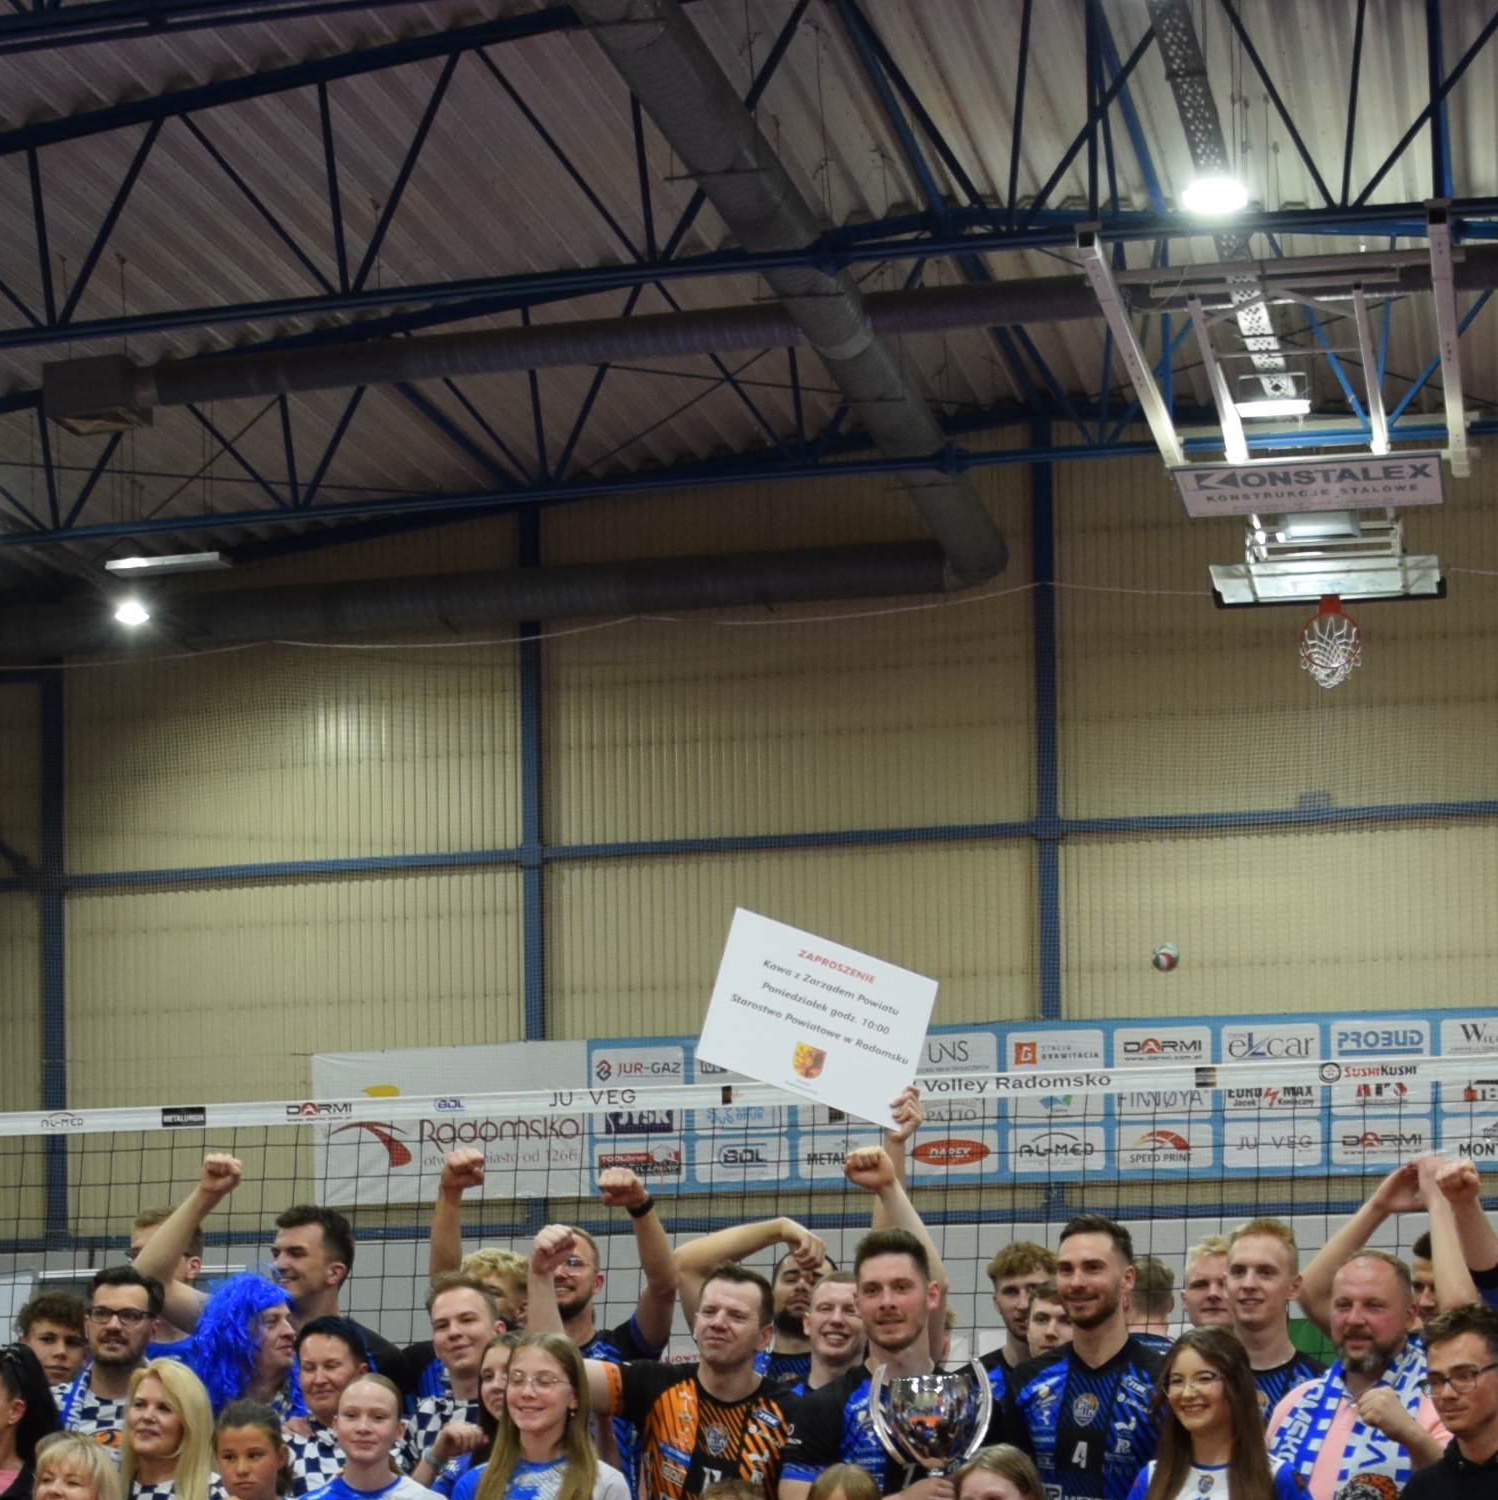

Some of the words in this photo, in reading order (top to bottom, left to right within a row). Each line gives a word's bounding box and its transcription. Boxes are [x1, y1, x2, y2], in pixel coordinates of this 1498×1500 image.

[1194, 463, 1433, 491] KONSTALEX
[1206, 488, 1329, 503] KONSTRUKCJE
[1340, 484, 1418, 496] STALOWE
[798, 949, 876, 984] ZAPROSZENIE
[762, 959, 792, 976] Kawa
[802, 974, 855, 999] Zarządem
[857, 993, 899, 1016] Powiatu
[761, 982, 829, 1013] Poniedziałek
[829, 1007, 858, 1024] godz.
[862, 1018, 890, 1035] 10:00
[730, 993, 782, 1018] Starostwo
[784, 1013, 841, 1040] Powiatowe
[855, 1039, 909, 1065] Radomsku
[1124, 1038, 1202, 1053] DARMI
[1337, 1030, 1424, 1048] PROBUD
[1042, 1051, 1099, 1061] GRAWITACJA
[617, 1062, 681, 1077] JUR-GAZ
[922, 1077, 988, 1094] Volley
[995, 1073, 1112, 1091] Radomsko
[549, 1091, 573, 1107] JU
[589, 1089, 636, 1106] VEG
[1282, 1086, 1313, 1097] MAX
[286, 1102, 351, 1116] DARMI
[1232, 1099, 1257, 1107] Jacek
[619, 1109, 671, 1125] JYSK
[926, 1109, 977, 1122] PATIO
[419, 1115, 580, 1153] Radomsko
[1342, 1132, 1422, 1147] DARMI
[1270, 1135, 1312, 1149] VEG
[523, 1149, 540, 1162] od
[723, 1149, 766, 1163] BDL
[1130, 1153, 1161, 1163] SPEED
[1163, 1152, 1192, 1162] PRINT
[1071, 1441, 1088, 1469] 4
